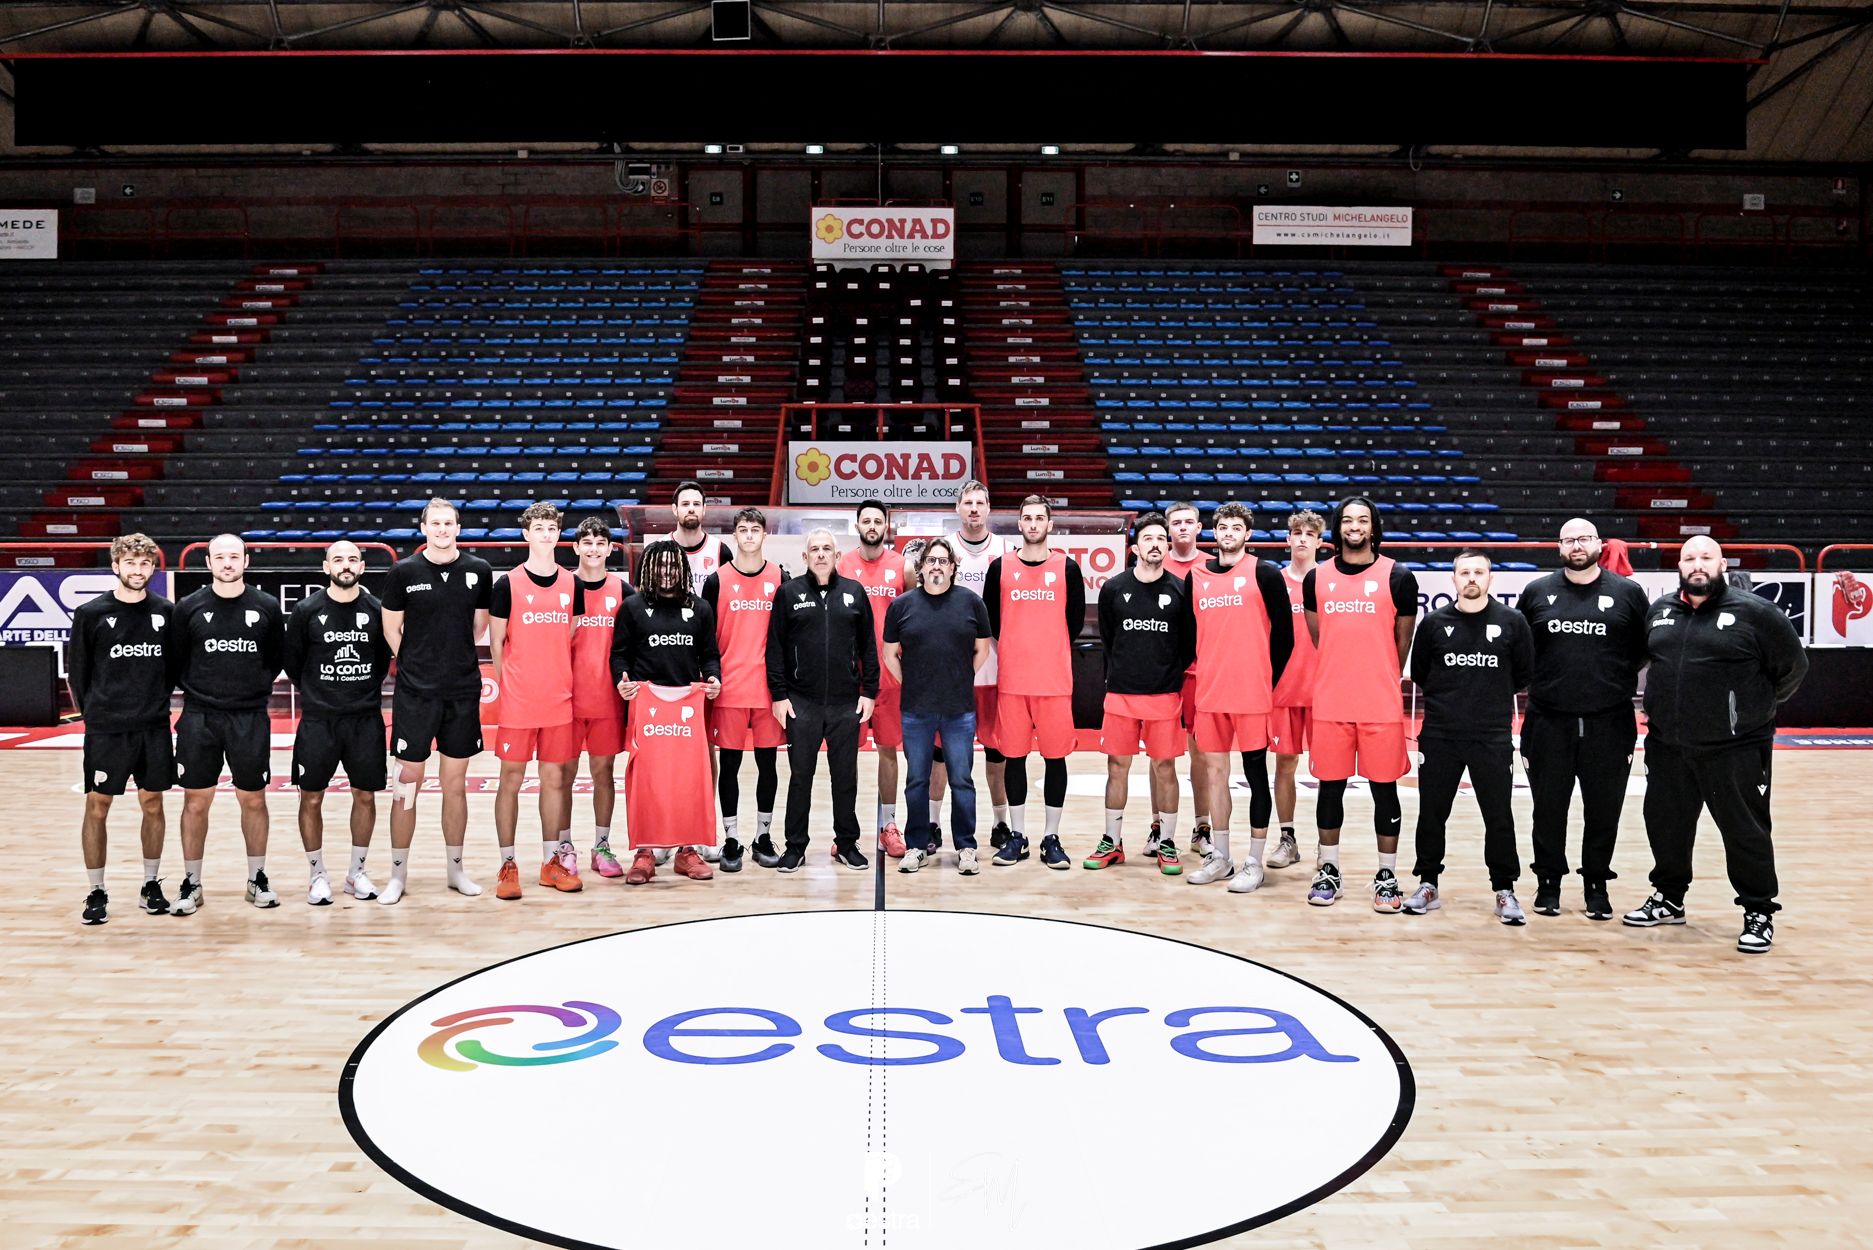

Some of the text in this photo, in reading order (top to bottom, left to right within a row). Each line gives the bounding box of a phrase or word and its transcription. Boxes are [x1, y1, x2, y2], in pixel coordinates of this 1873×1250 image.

[1258, 212, 1408, 223] CENTRO STUDI MICHELANGELO
[846, 218, 950, 239] CONAD
[843, 243, 881, 253] Persone
[885, 242, 908, 253] oltre
[912, 243, 920, 253] le
[834, 453, 967, 480] CONAD
[831, 484, 958, 498] Persone oltre le cose
[865, 583, 896, 597] estra
[1020, 587, 1055, 601] estra
[741, 599, 772, 611] estra
[1207, 594, 1243, 607] estra
[1335, 599, 1376, 613] estra
[534, 610, 569, 624] estra
[580, 613, 614, 627] estra
[1134, 618, 1168, 632] estra
[1560, 620, 1606, 635] estra
[0, 630, 71, 641] RTE DELL
[335, 628, 368, 642] estra
[659, 633, 693, 645] estra
[121, 642, 161, 656] estra
[213, 638, 257, 652] estra
[1455, 652, 1498, 667] estra
[320, 663, 335, 675] LO
[655, 723, 692, 737] estra
[643, 995, 1360, 1066] estra
